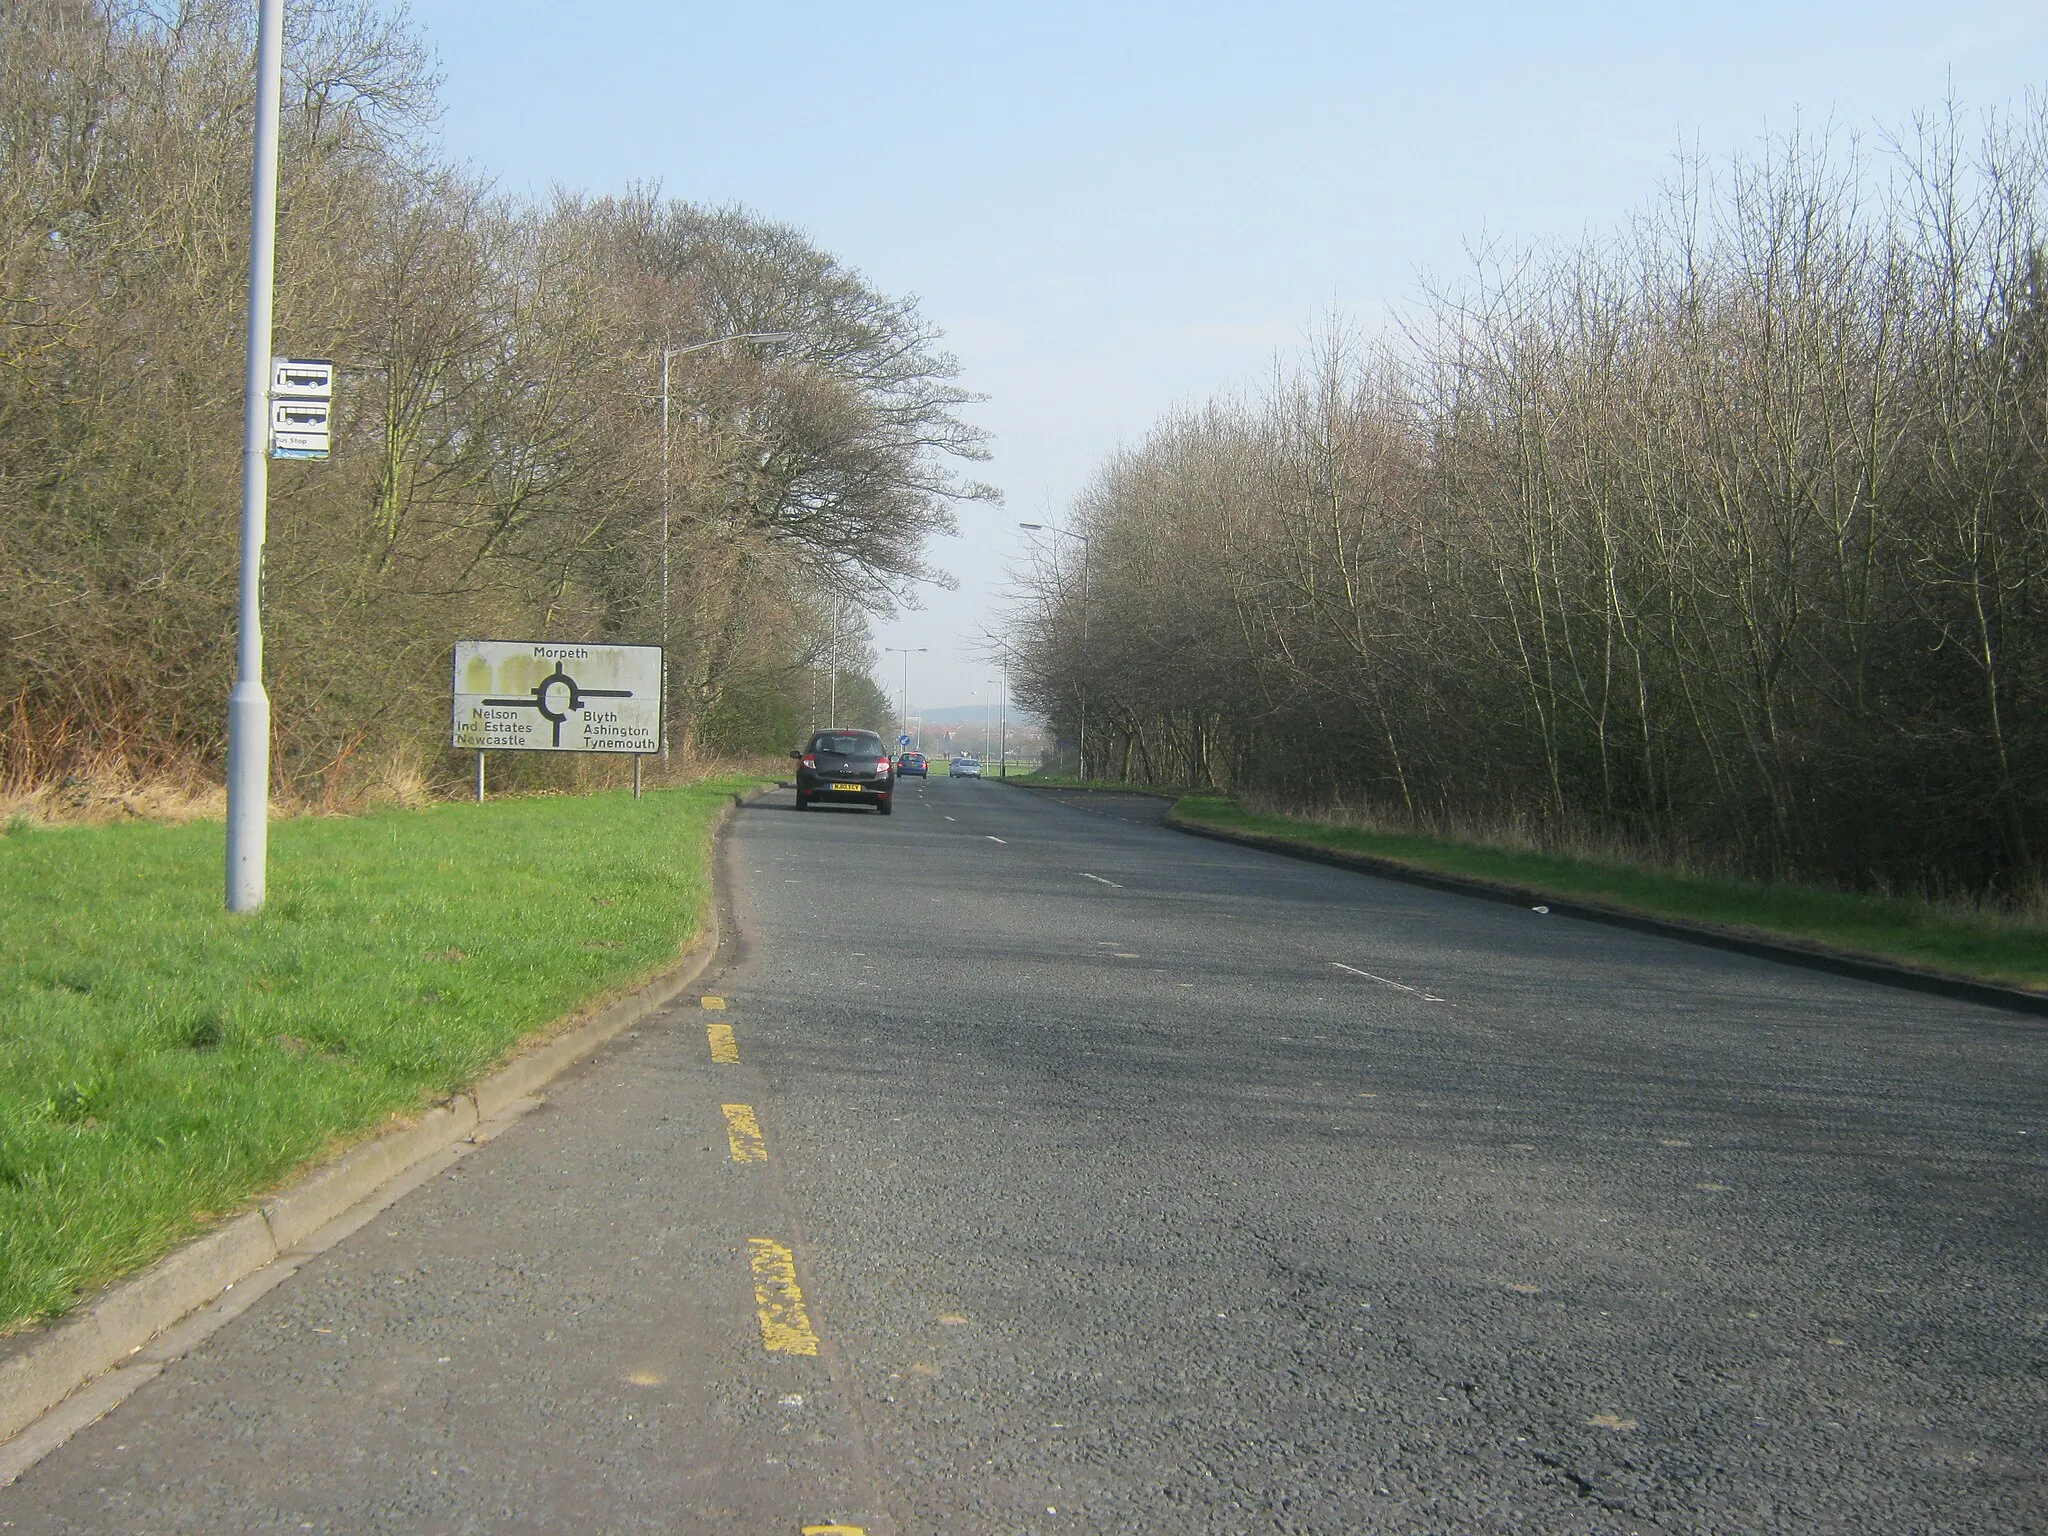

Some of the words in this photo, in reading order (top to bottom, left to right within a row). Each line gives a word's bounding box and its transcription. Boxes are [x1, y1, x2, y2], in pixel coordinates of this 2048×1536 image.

[534, 647, 588, 660] Morpeth
[472, 708, 518, 720] Nelson
[583, 711, 617, 724] Blyth
[457, 722, 478, 732] Ind
[484, 722, 532, 733] Estates
[583, 724, 649, 738] Ashington
[456, 734, 526, 746] Newcastle
[583, 737, 655, 750] Tynemouth
